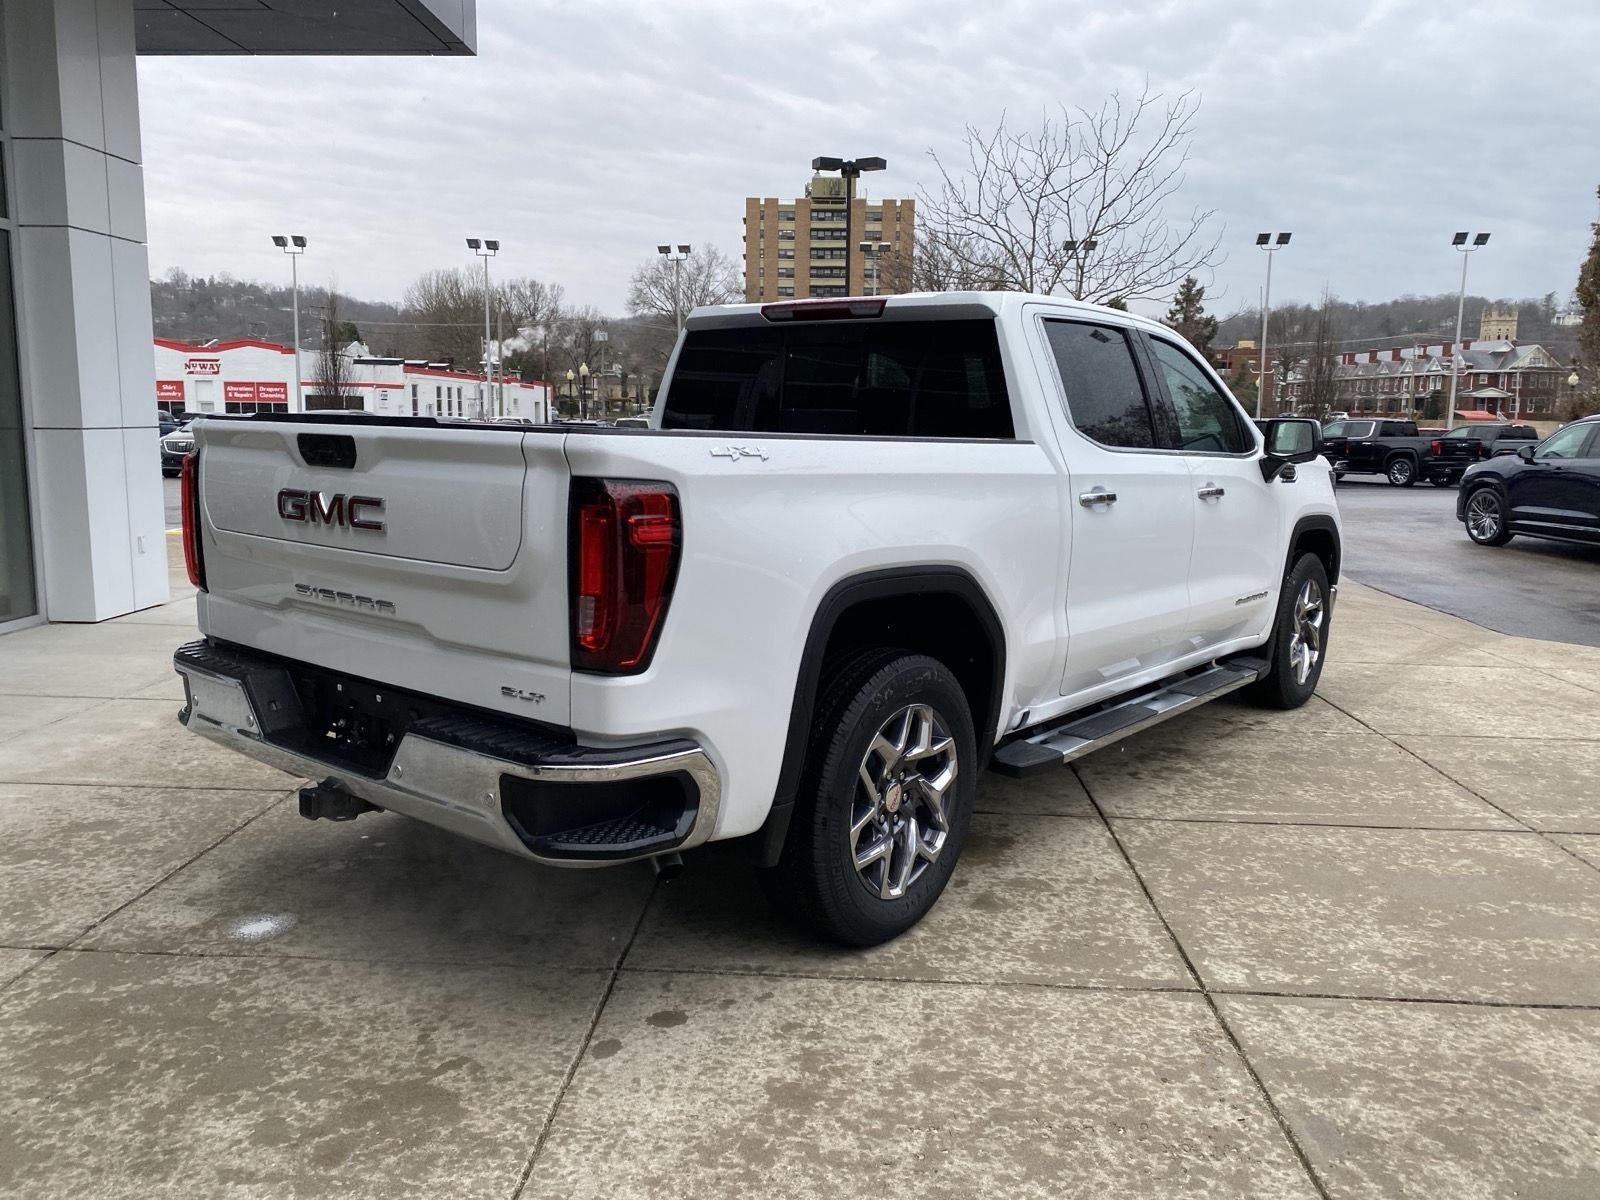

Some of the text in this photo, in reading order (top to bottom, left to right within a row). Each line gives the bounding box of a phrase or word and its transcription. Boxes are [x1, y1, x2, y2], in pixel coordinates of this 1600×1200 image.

[277, 487, 387, 531] GMC
[294, 583, 396, 614] SIERRA
[500, 686, 547, 704] SLT
